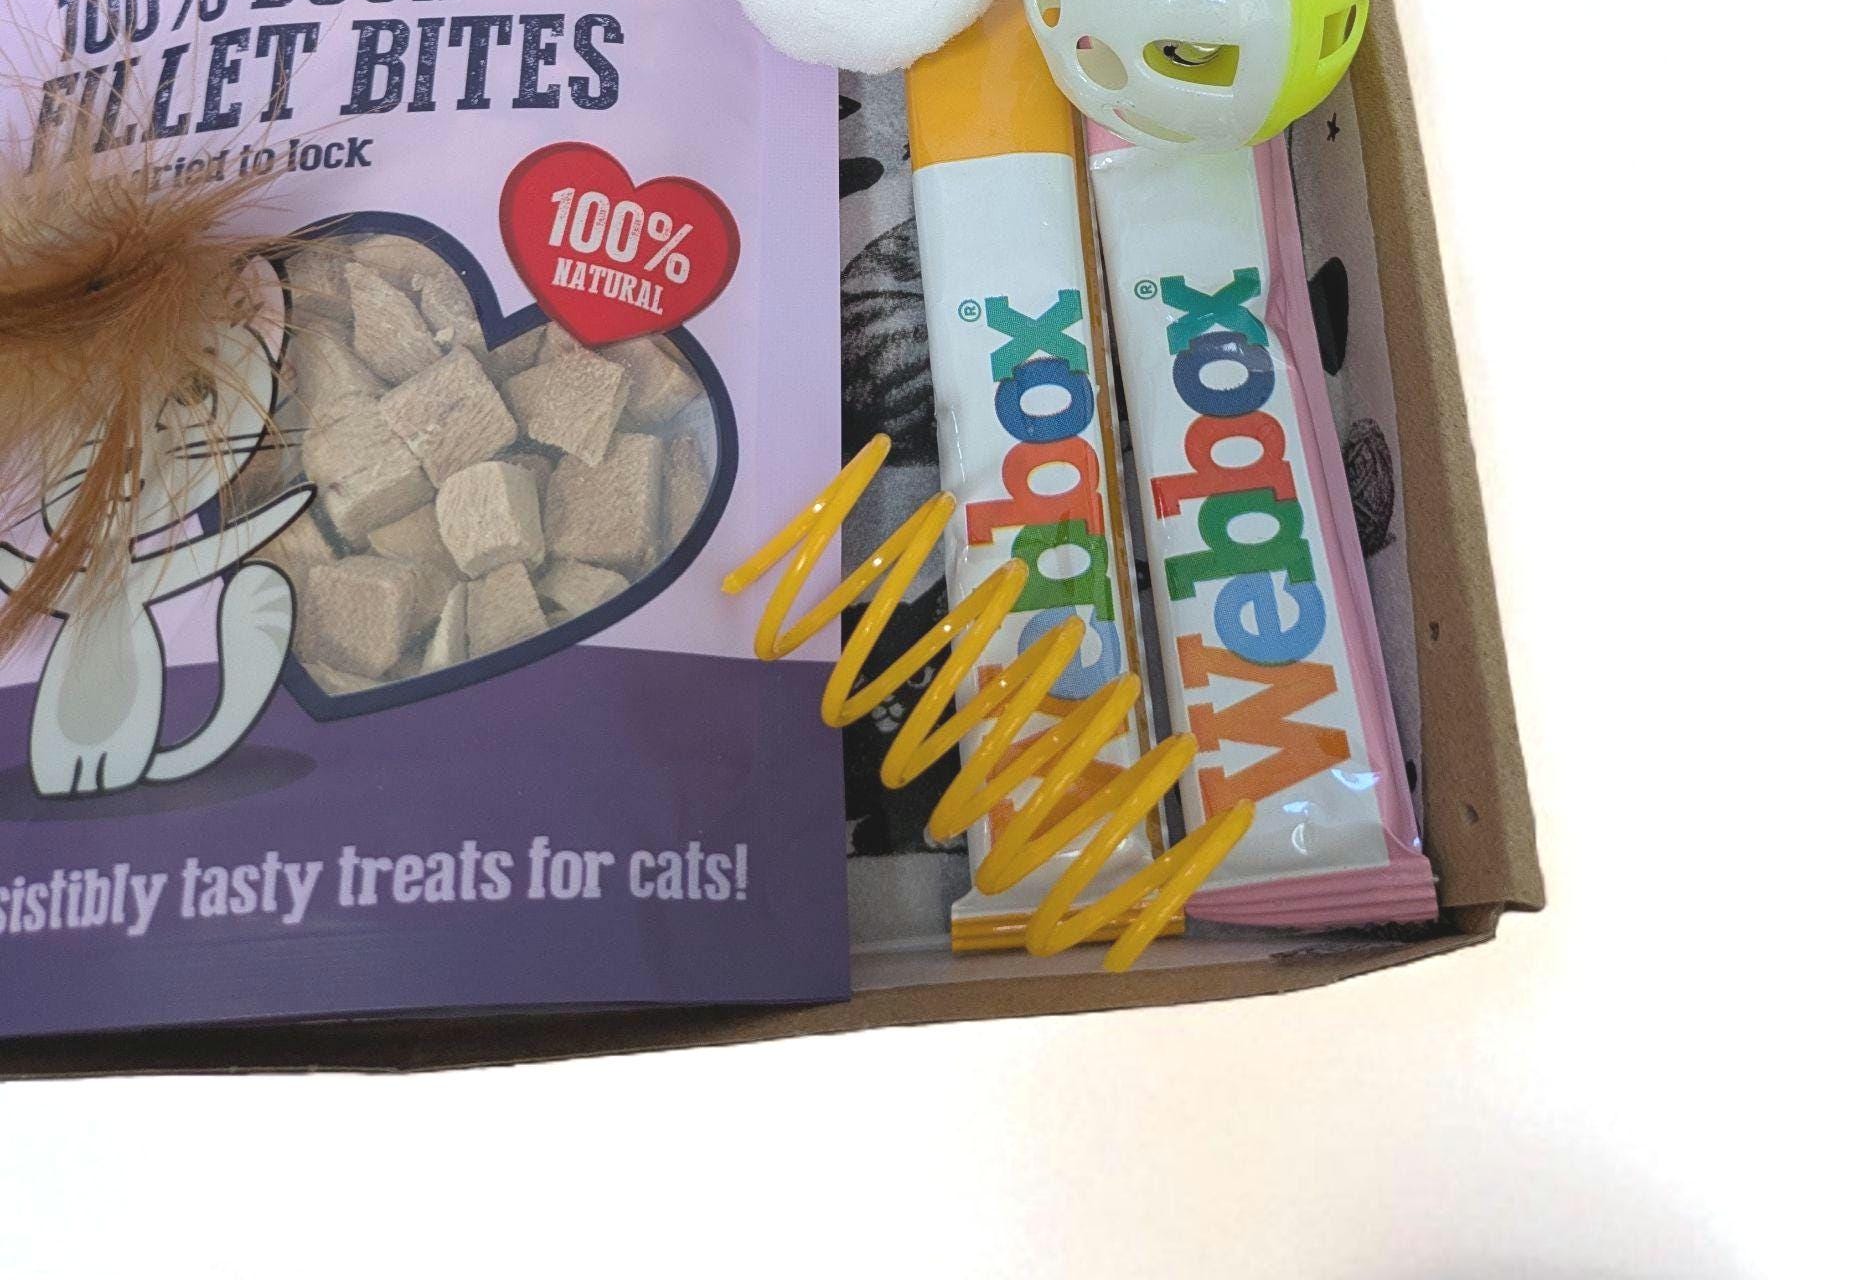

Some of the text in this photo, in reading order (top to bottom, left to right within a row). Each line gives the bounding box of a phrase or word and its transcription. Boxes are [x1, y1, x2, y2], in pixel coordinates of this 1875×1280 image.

[28, 12, 625, 176] FILLET BITES
[238, 143, 277, 177] to
[287, 136, 374, 173] lock
[549, 186, 694, 286] 100%
[552, 257, 665, 316] NATURAL
[1151, 266, 1350, 821] Webbox
[180, 848, 325, 925] tasty
[338, 839, 513, 908] treats
[527, 835, 616, 900] for
[628, 842, 749, 901] cats!
